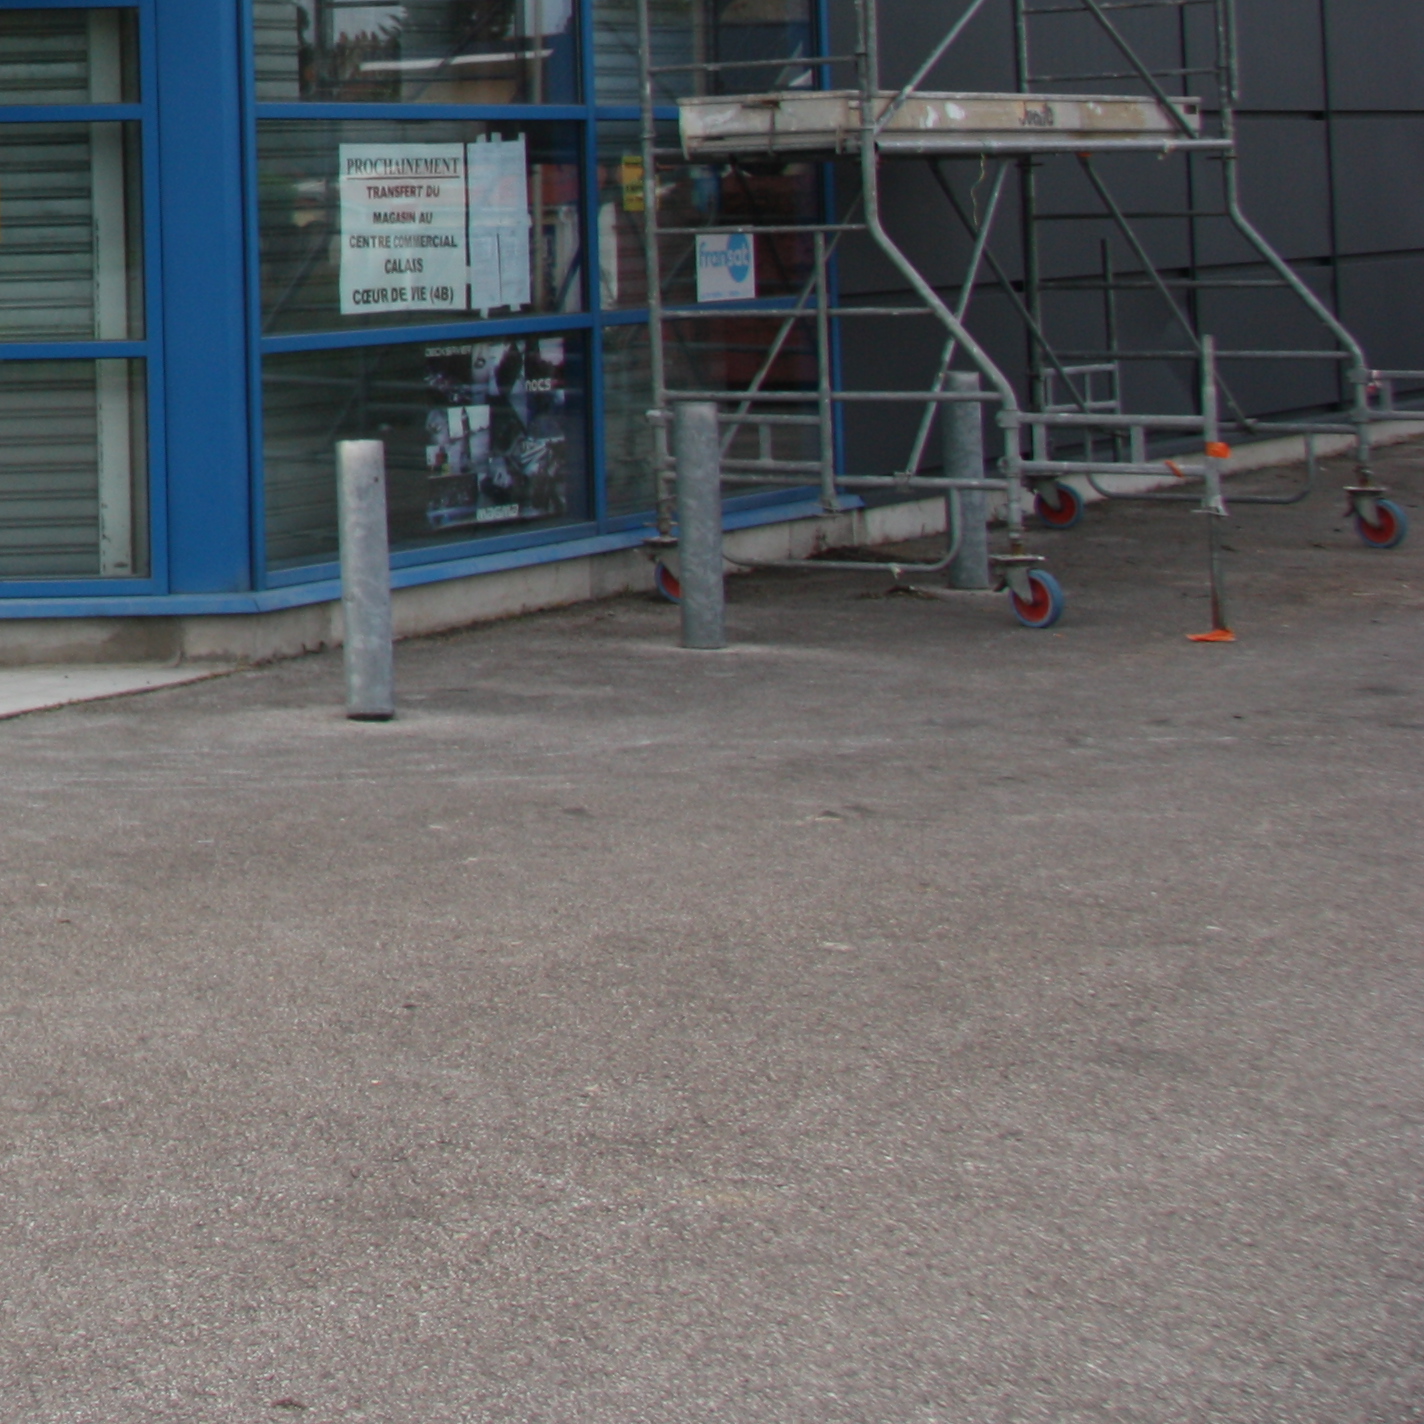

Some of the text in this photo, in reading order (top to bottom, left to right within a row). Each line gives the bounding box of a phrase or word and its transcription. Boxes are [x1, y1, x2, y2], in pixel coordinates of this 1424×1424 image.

[346, 158, 460, 176] PROCHAINEMENT
[366, 185, 440, 199] TRANSFERT DU
[372, 211, 433, 224] MAGASIN AU
[349, 235, 458, 249] CENTRE COMMERCIAL
[699, 240, 750, 268] fransat
[384, 257, 423, 274] CALAIS
[390, 287, 408, 303] DE
[429, 286, 454, 304] (4B)
